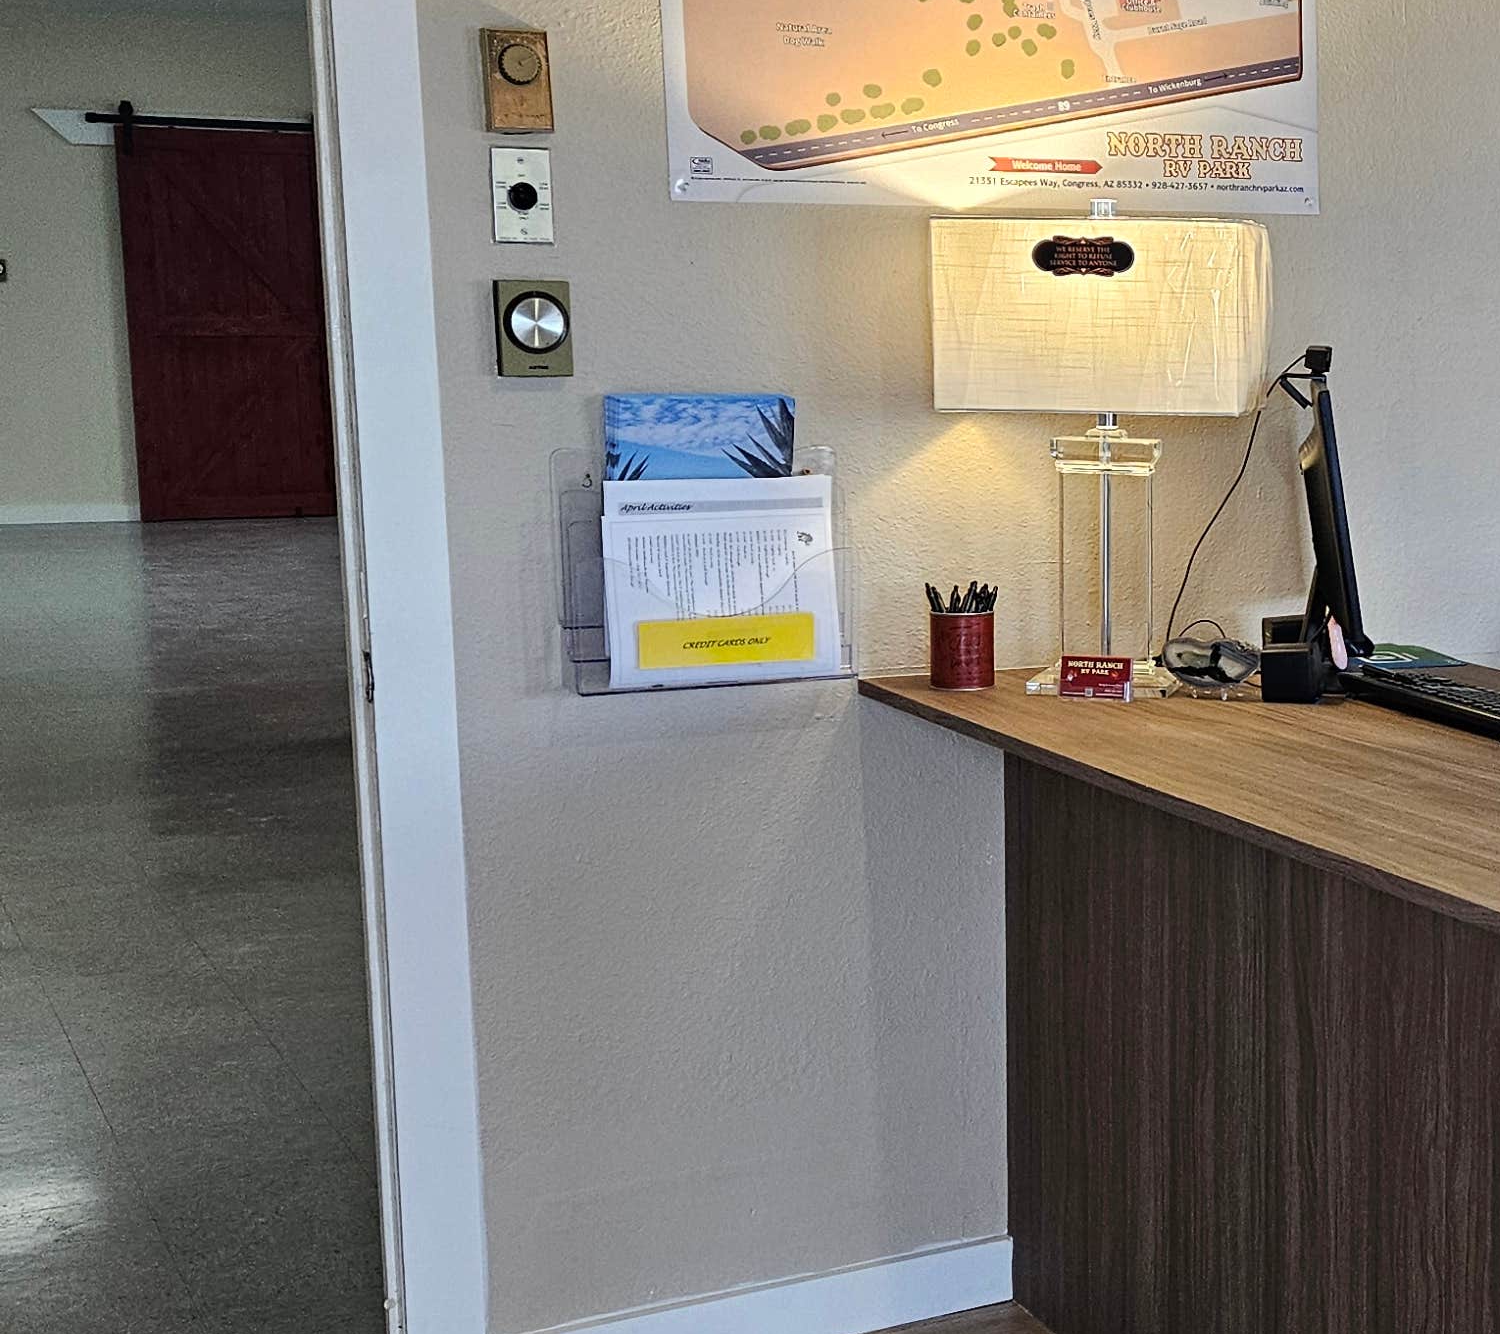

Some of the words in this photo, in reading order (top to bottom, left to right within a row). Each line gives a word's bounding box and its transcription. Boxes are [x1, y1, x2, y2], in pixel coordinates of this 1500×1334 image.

[1148, 85, 1158, 95] To
[1158, 78, 1202, 93] Wickenburg
[1057, 100, 1071, 112] 89
[911, 124, 923, 134] To
[922, 118, 960, 133] Congress
[1107, 131, 1203, 159] NORTH
[1209, 135, 1303, 162] RANCH
[1012, 160, 1053, 171] Welcome
[1054, 161, 1082, 172] Home
[1163, 158, 1192, 178] RV
[1198, 160, 1252, 180] PARK
[968, 176, 997, 186] 21351
[1000, 178, 1038, 188] Escapees
[1040, 178, 1060, 188] Way,
[1103, 180, 1115, 188] AZ
[1151, 181, 1209, 190] 928-427-3657
[682, 639, 718, 650] CREDIT
[717, 637, 746, 648] CARDS
[747, 636, 772, 646] ONLY
[1067, 659, 1095, 669] NORTH
[1095, 661, 1124, 670] RANCH
